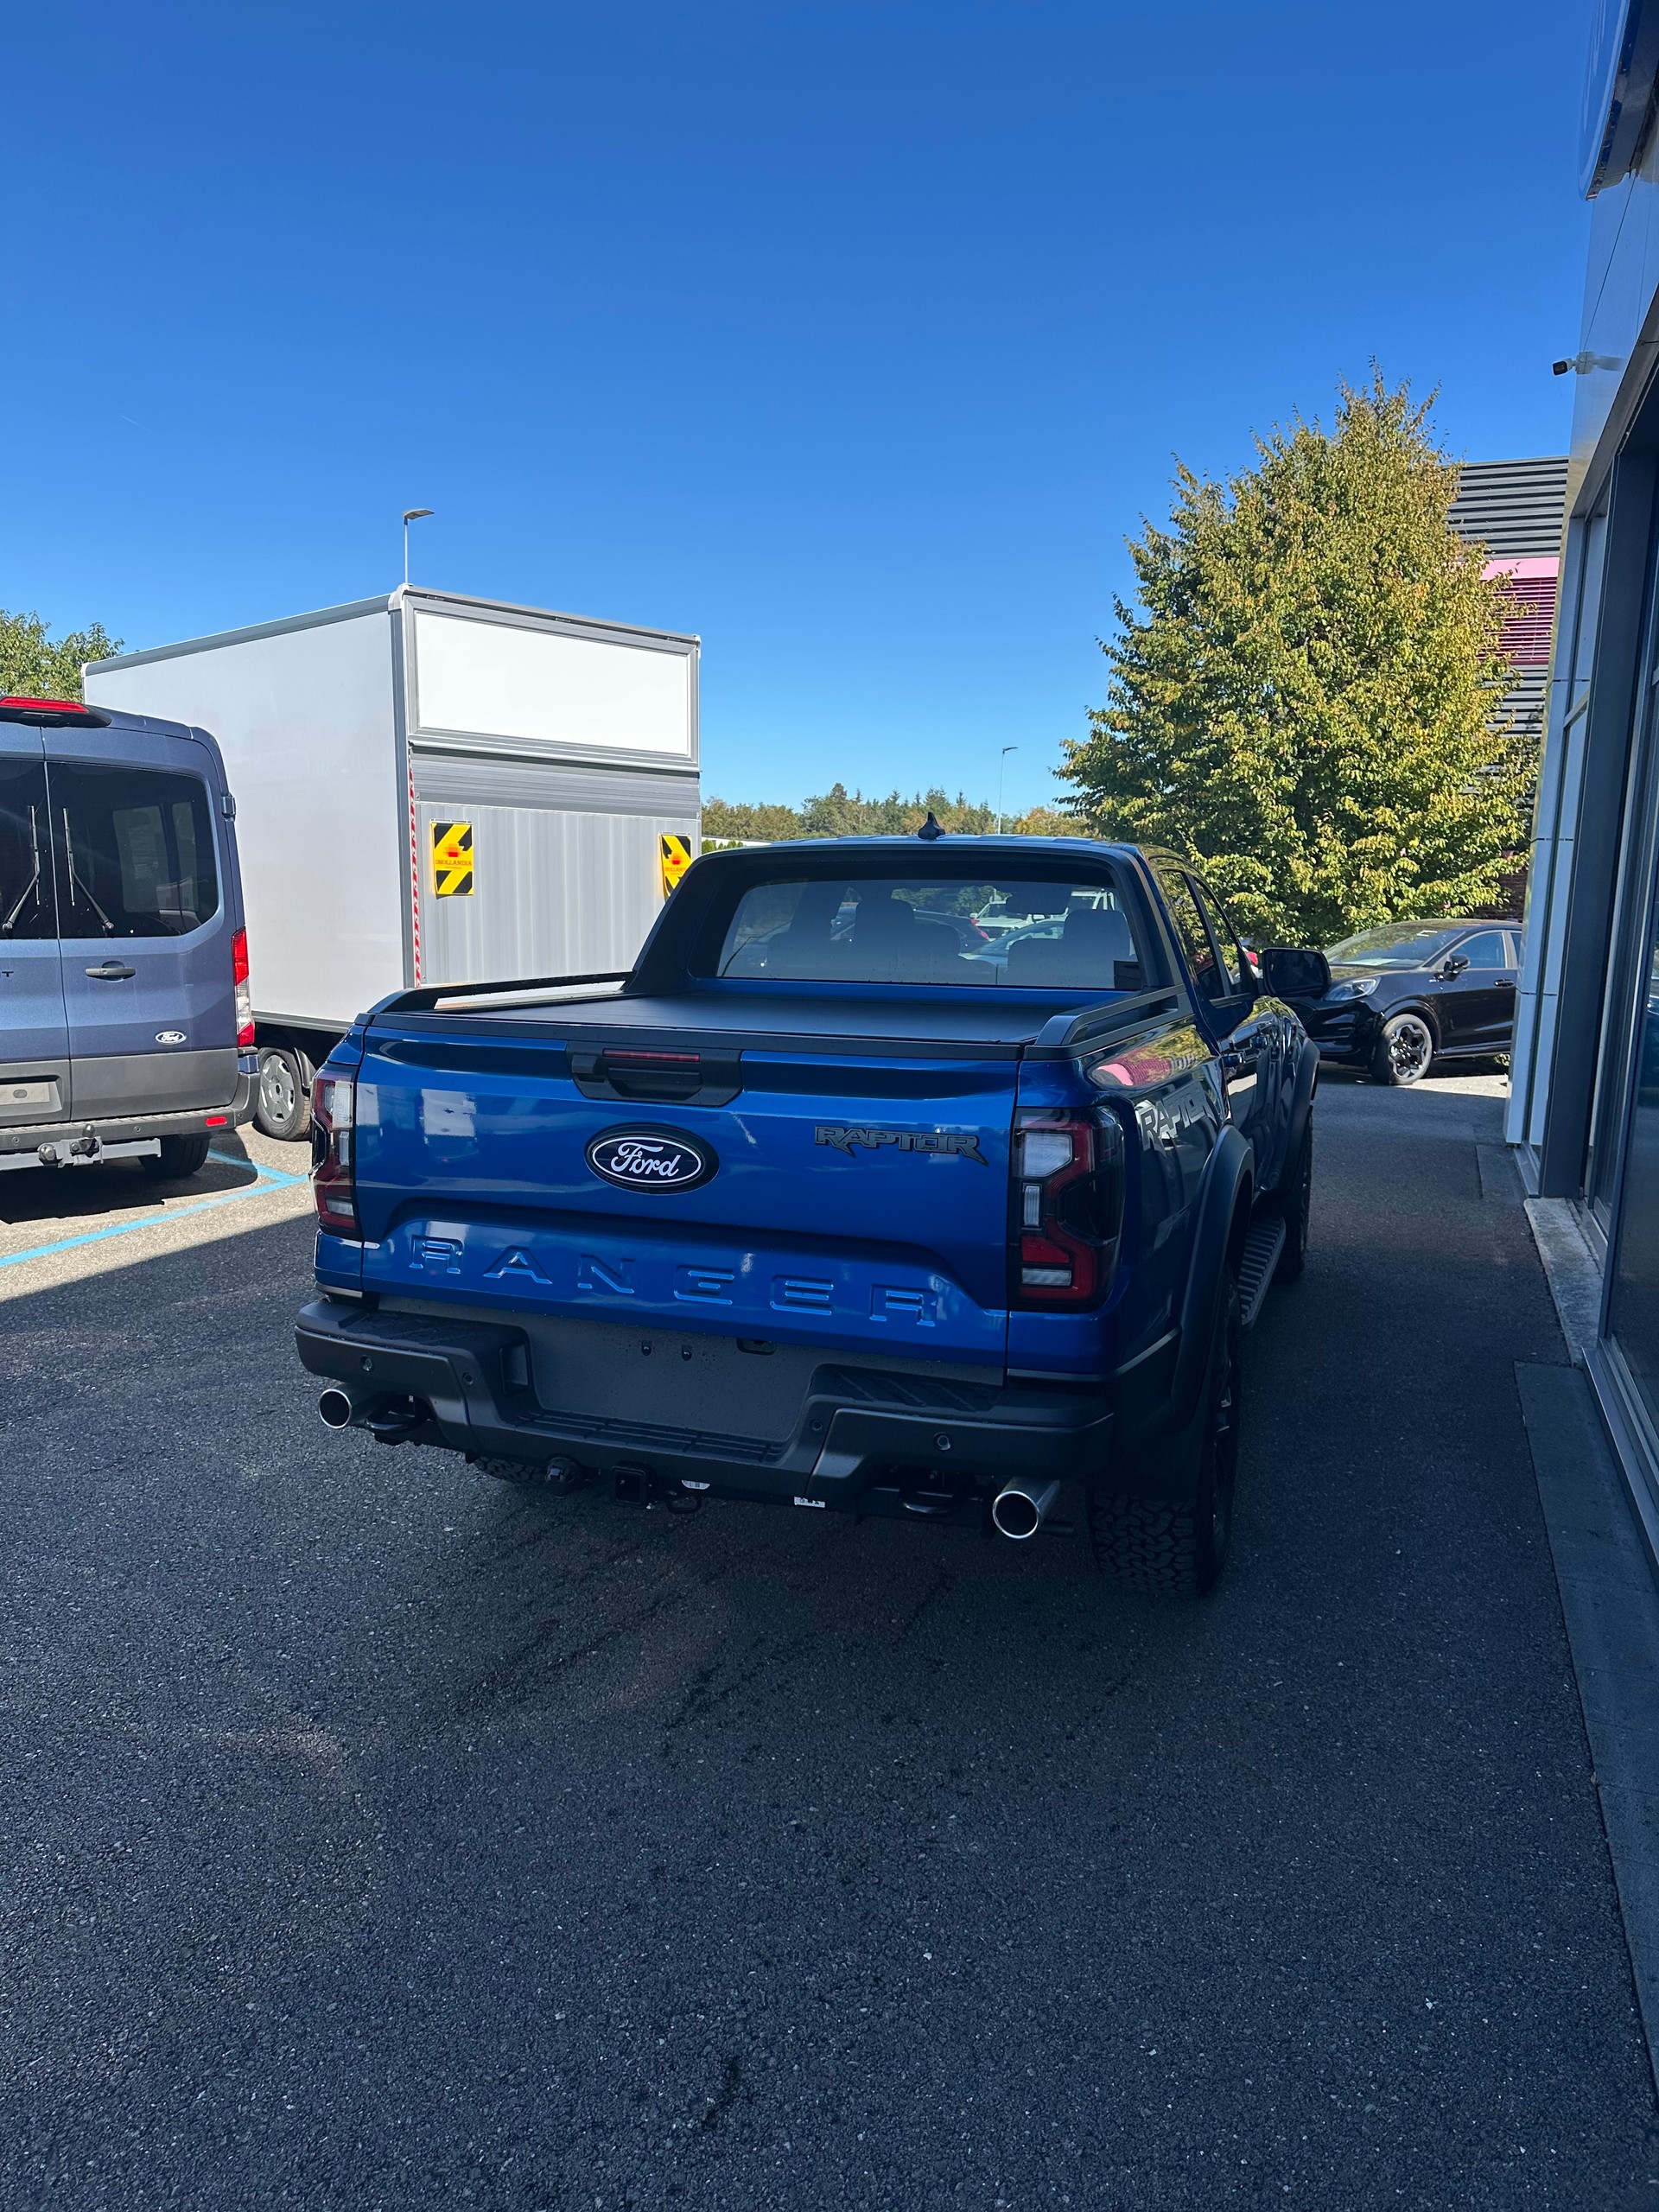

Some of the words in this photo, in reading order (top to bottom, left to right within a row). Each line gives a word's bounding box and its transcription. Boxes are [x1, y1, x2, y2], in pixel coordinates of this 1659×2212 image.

[610, 1141, 682, 1177] Ford
[815, 1126, 989, 1166] RAPTOR
[409, 1234, 938, 1327] RANGER
